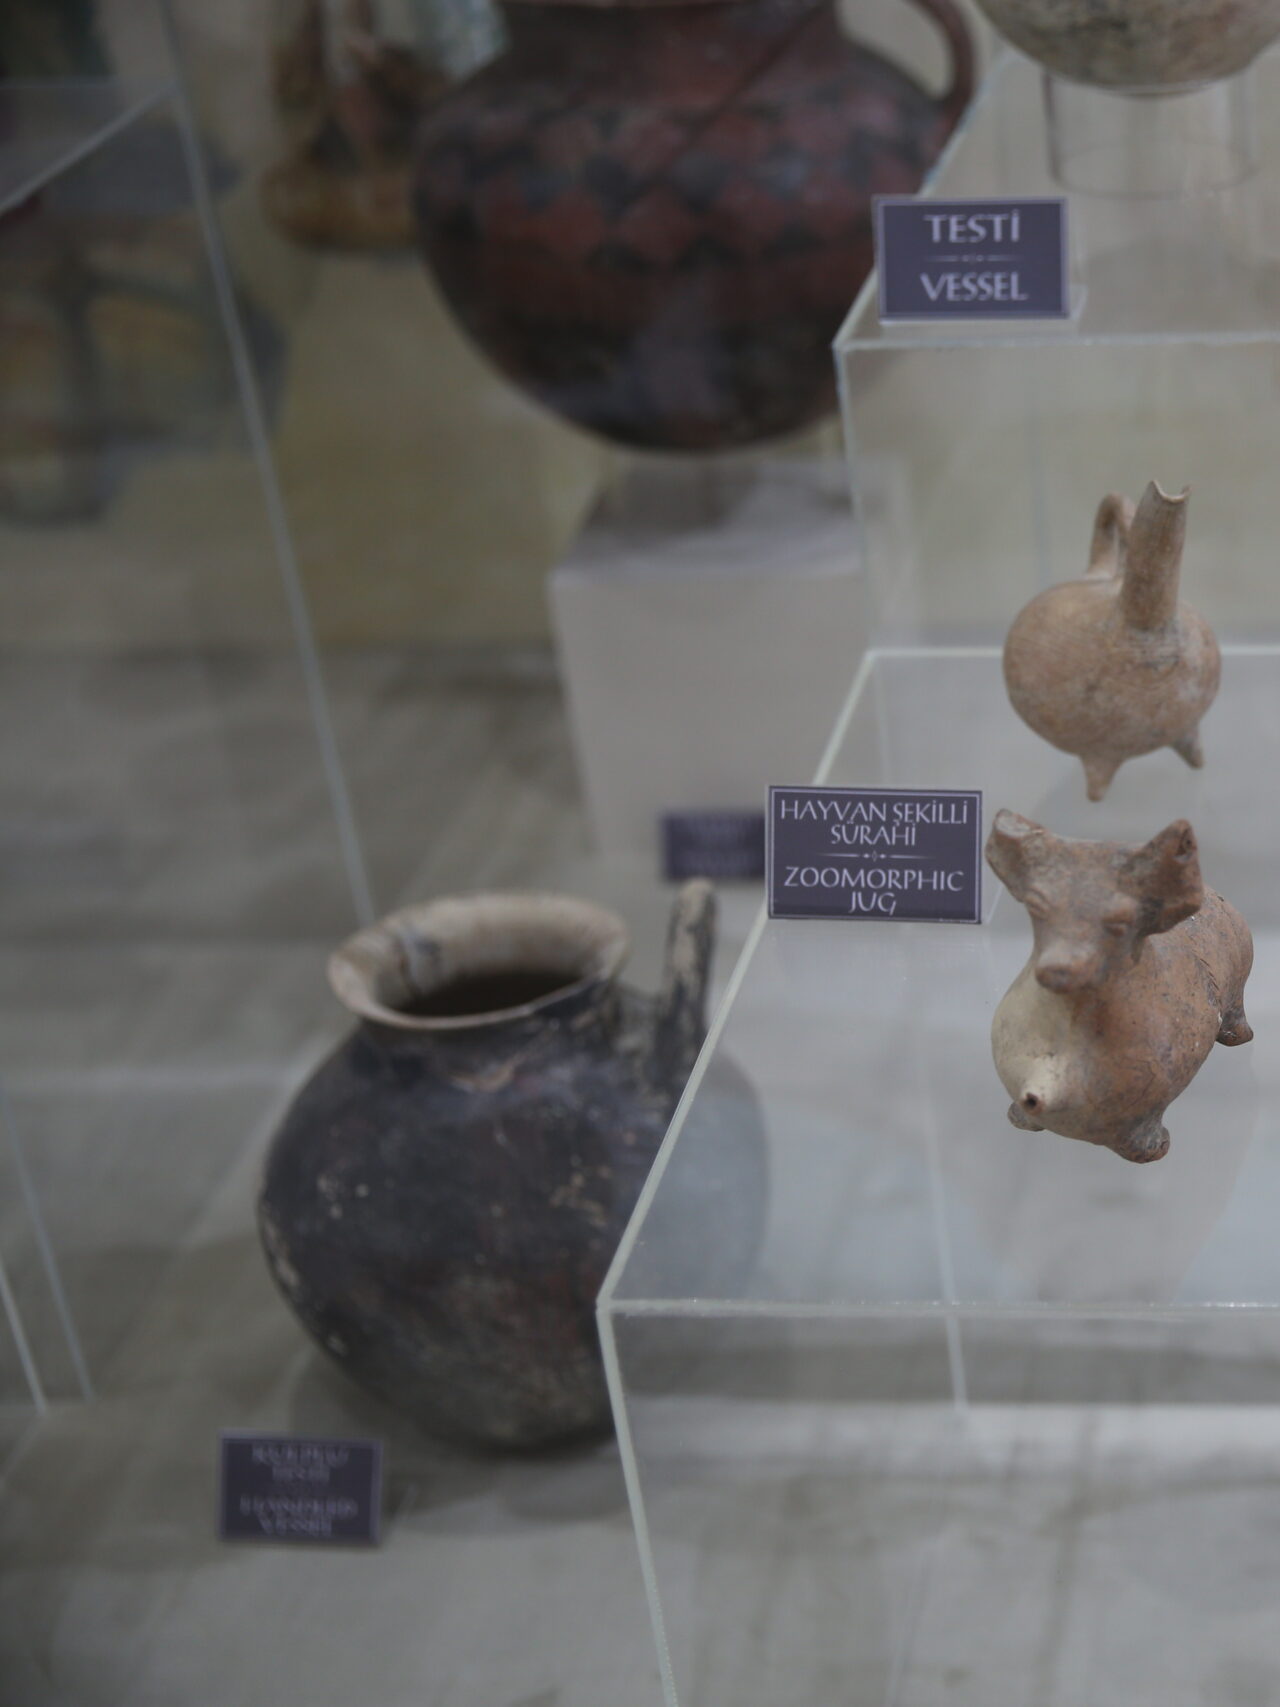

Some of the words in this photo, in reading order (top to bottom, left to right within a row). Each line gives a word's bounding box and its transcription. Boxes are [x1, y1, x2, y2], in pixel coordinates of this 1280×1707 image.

[924, 208, 1020, 243] TESTİ
[920, 271, 1029, 301] VESSEL
[781, 799, 887, 822] HAYVAN
[892, 800, 969, 827] ŞEKİLLİ
[831, 820, 917, 846] SÜRAHİ
[784, 866, 965, 892] ZOOMORPHIC
[848, 891, 897, 916] JUG
